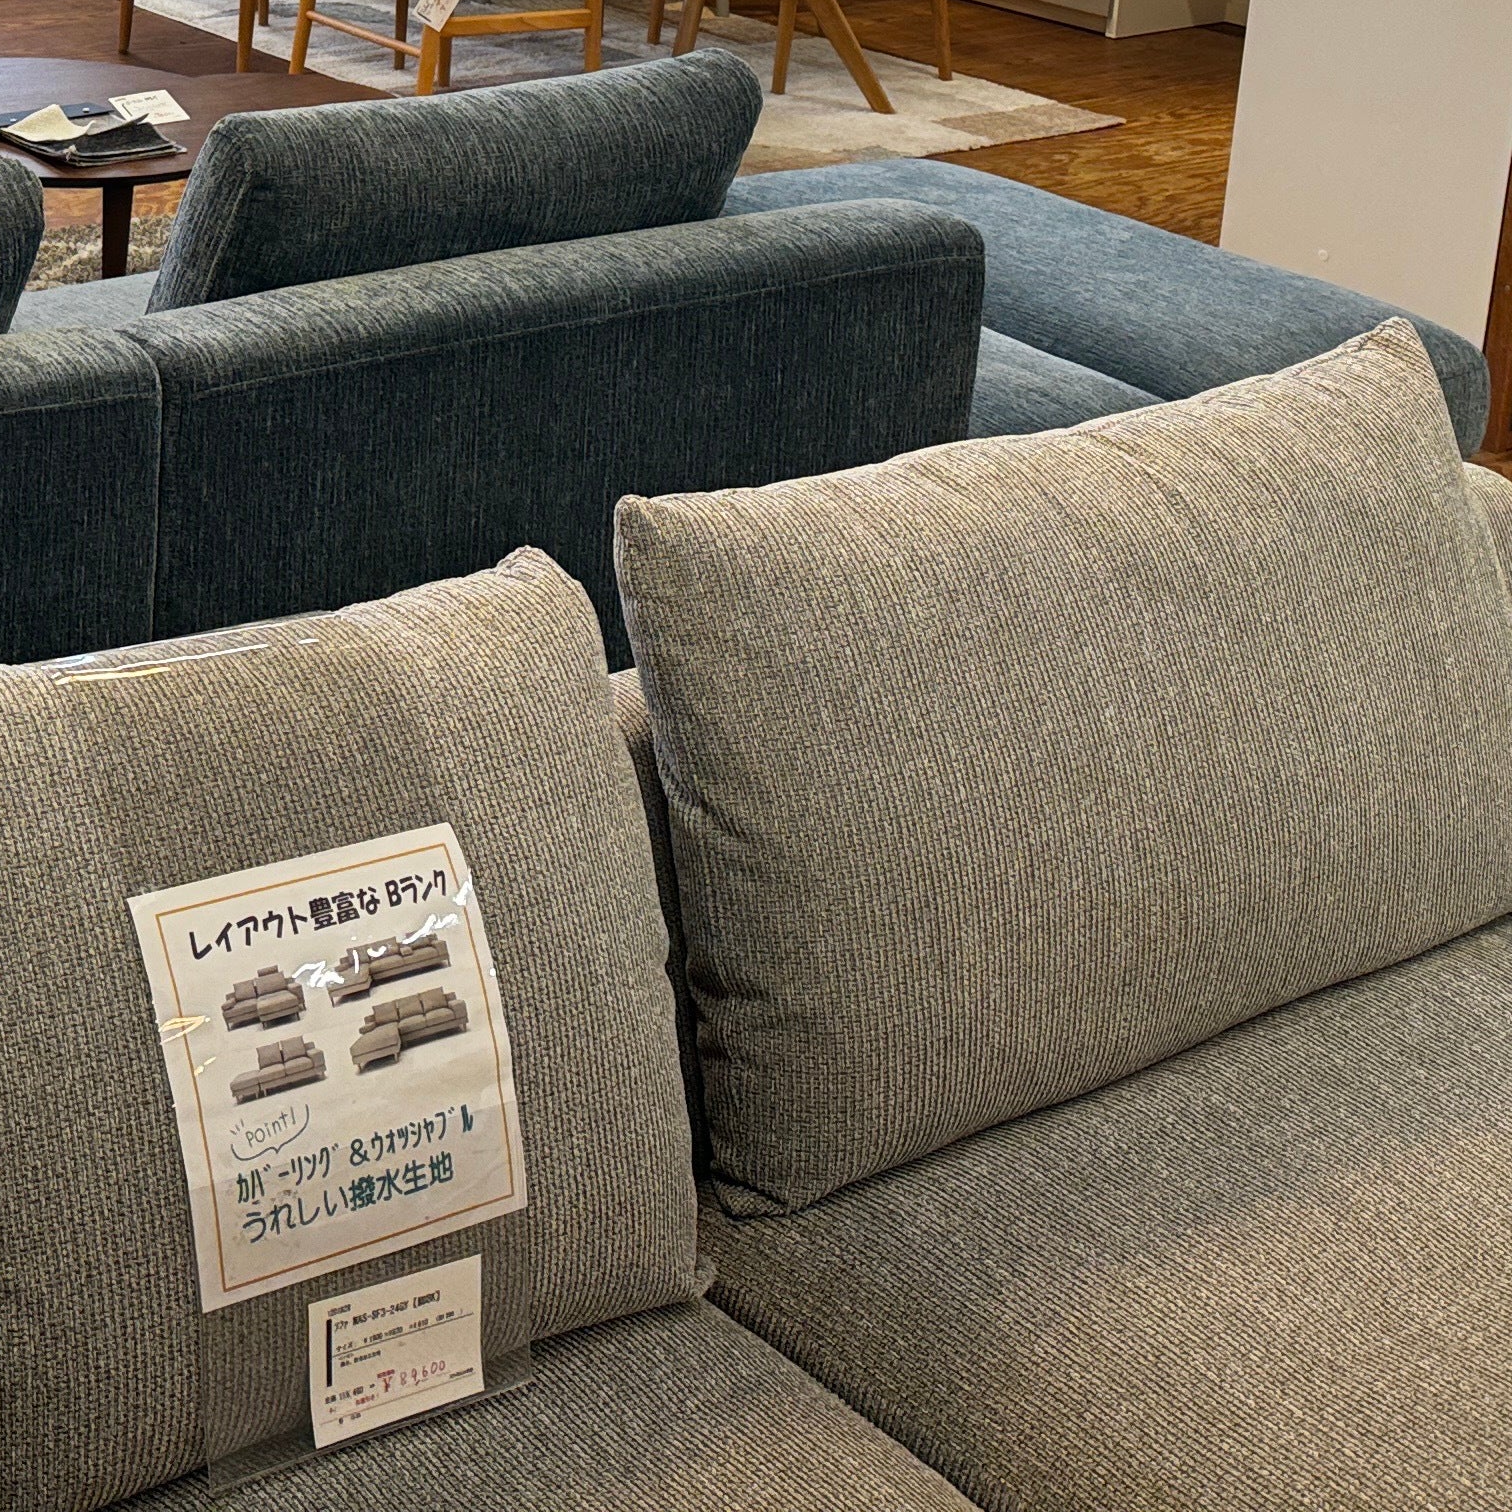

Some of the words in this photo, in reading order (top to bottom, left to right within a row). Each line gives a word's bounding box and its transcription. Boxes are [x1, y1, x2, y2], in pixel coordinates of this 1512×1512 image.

[243, 1150, 454, 1244] うれしい撥水生地
